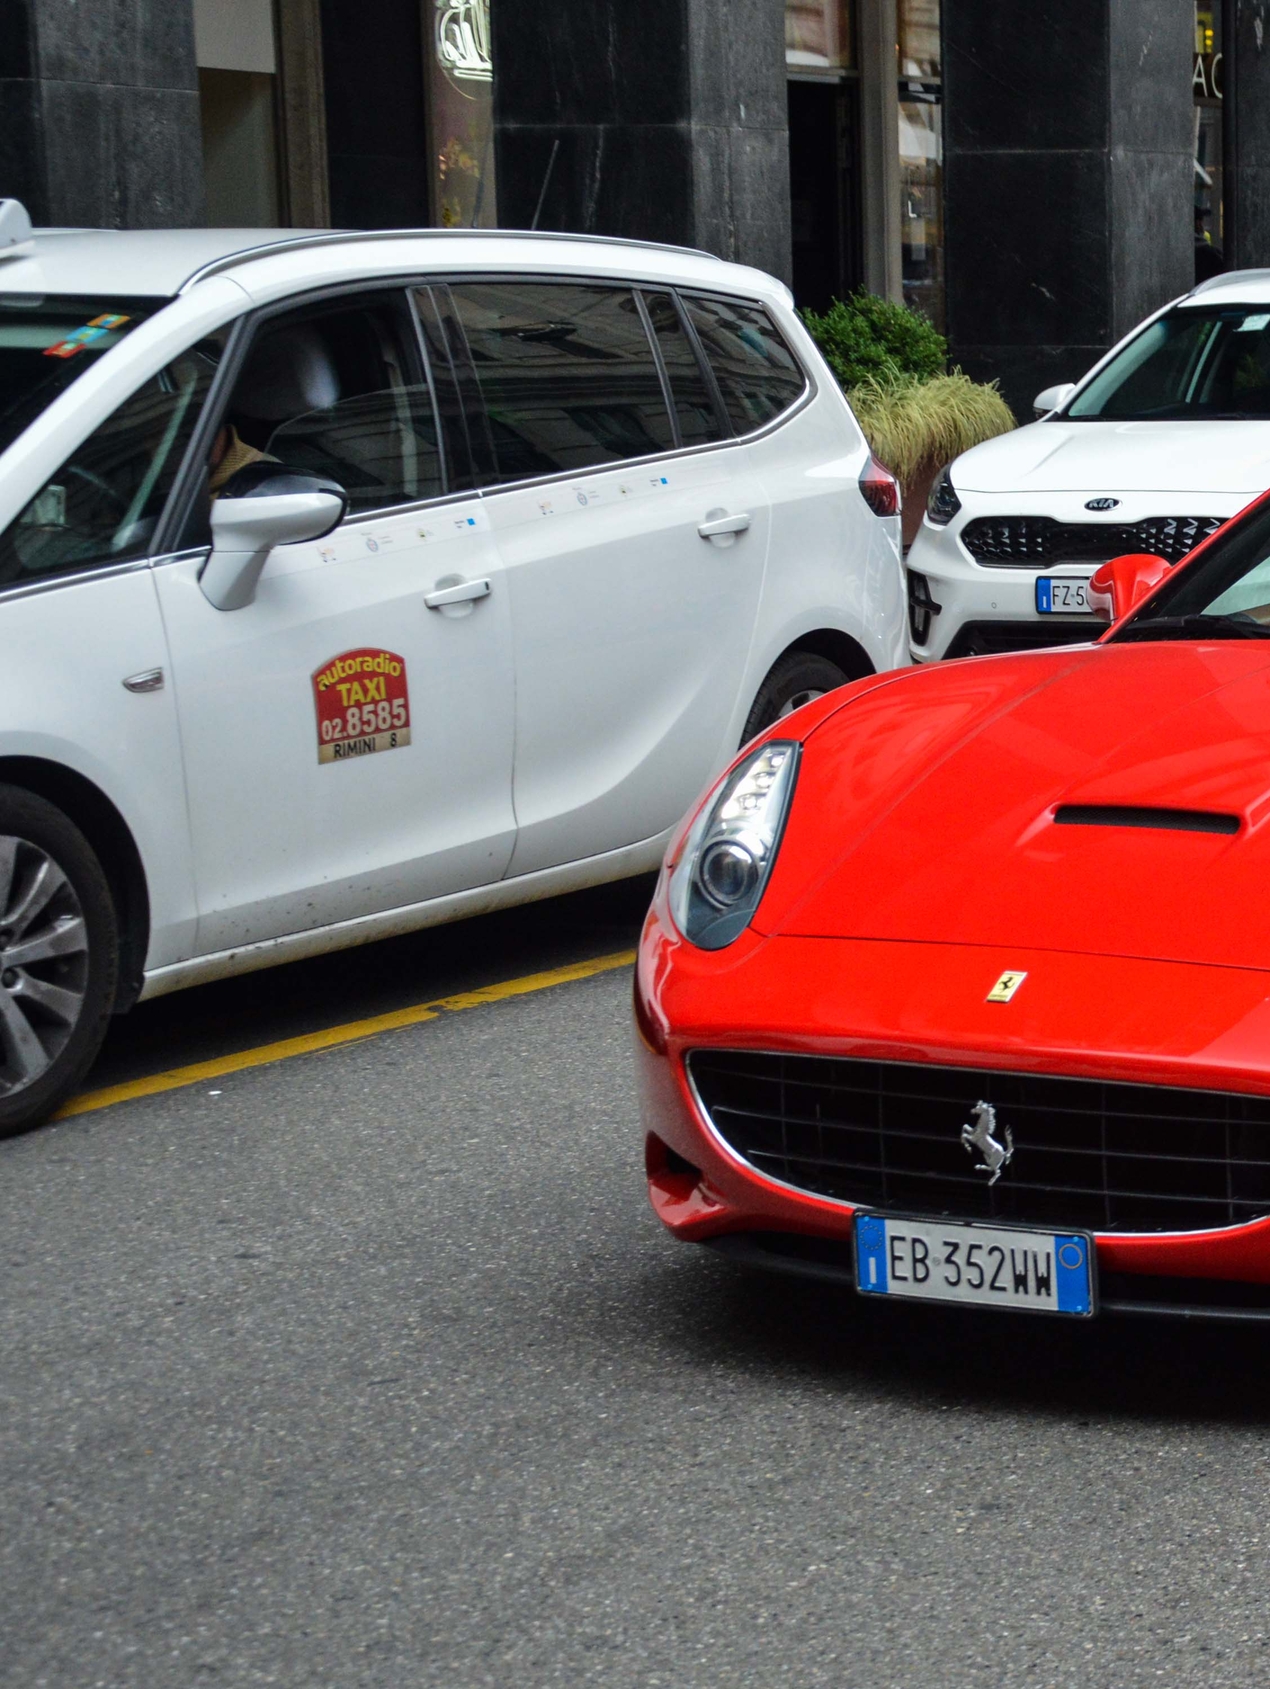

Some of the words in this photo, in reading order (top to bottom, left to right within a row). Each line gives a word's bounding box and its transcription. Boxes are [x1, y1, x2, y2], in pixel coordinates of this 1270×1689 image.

[1088, 499, 1115, 508] KIA
[317, 653, 401, 691] autoradio
[336, 676, 387, 707] TAXI
[321, 697, 406, 741] 02.8585
[333, 737, 376, 759] RIMINI
[390, 732, 397, 748] 8
